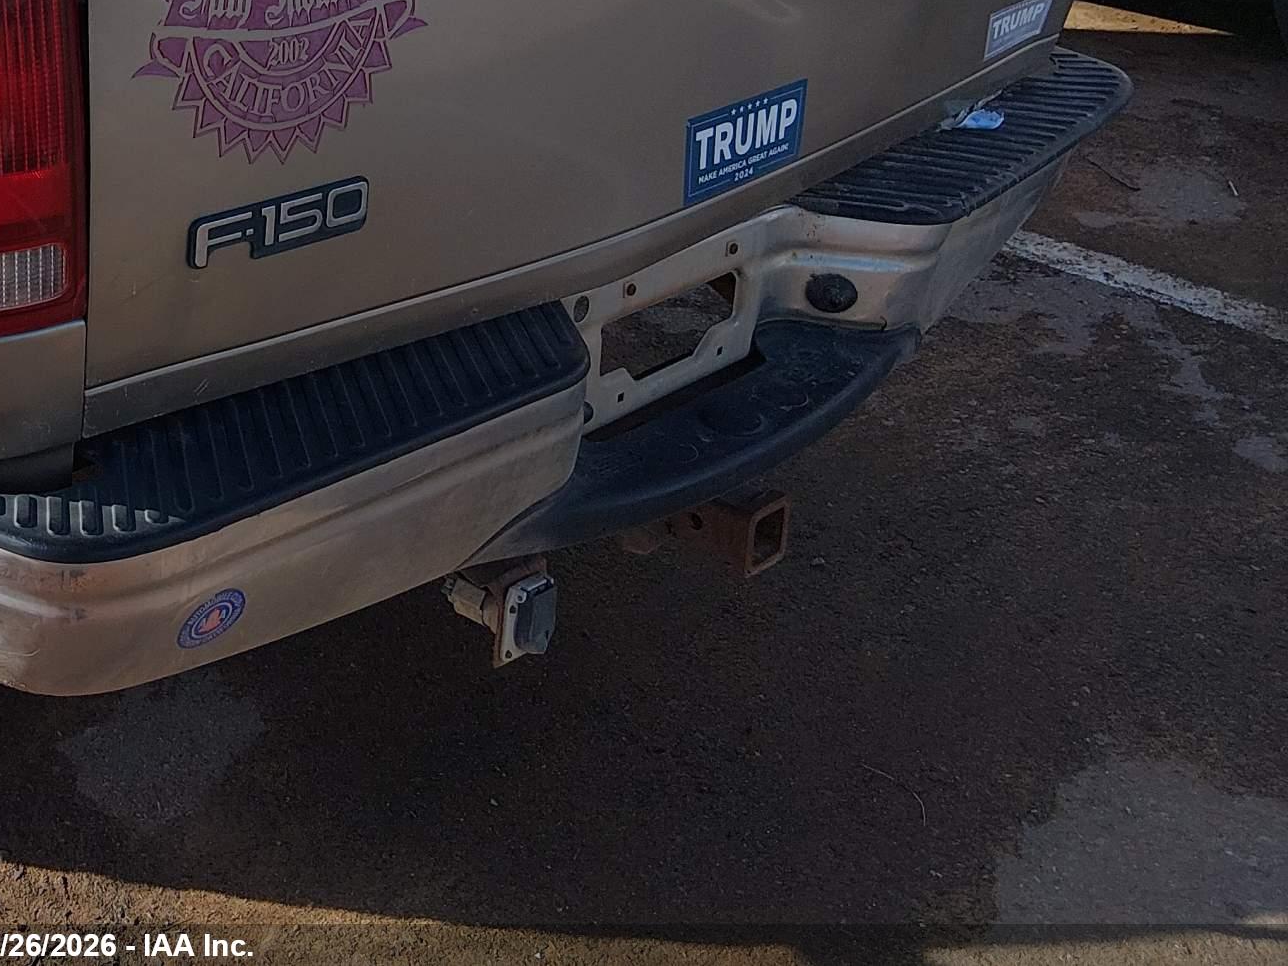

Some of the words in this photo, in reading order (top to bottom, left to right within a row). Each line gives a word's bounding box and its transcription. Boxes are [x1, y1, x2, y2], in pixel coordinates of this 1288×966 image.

[992, 3, 1045, 40] TRUMP
[203, 17, 374, 115] CALIFORNIA
[267, 37, 310, 67] 2002
[695, 98, 798, 170] TRUMP
[698, 171, 718, 185] MAKE
[718, 159, 747, 177] AMERICA
[747, 150, 768, 165] GREAT
[733, 166, 754, 182] 2024
